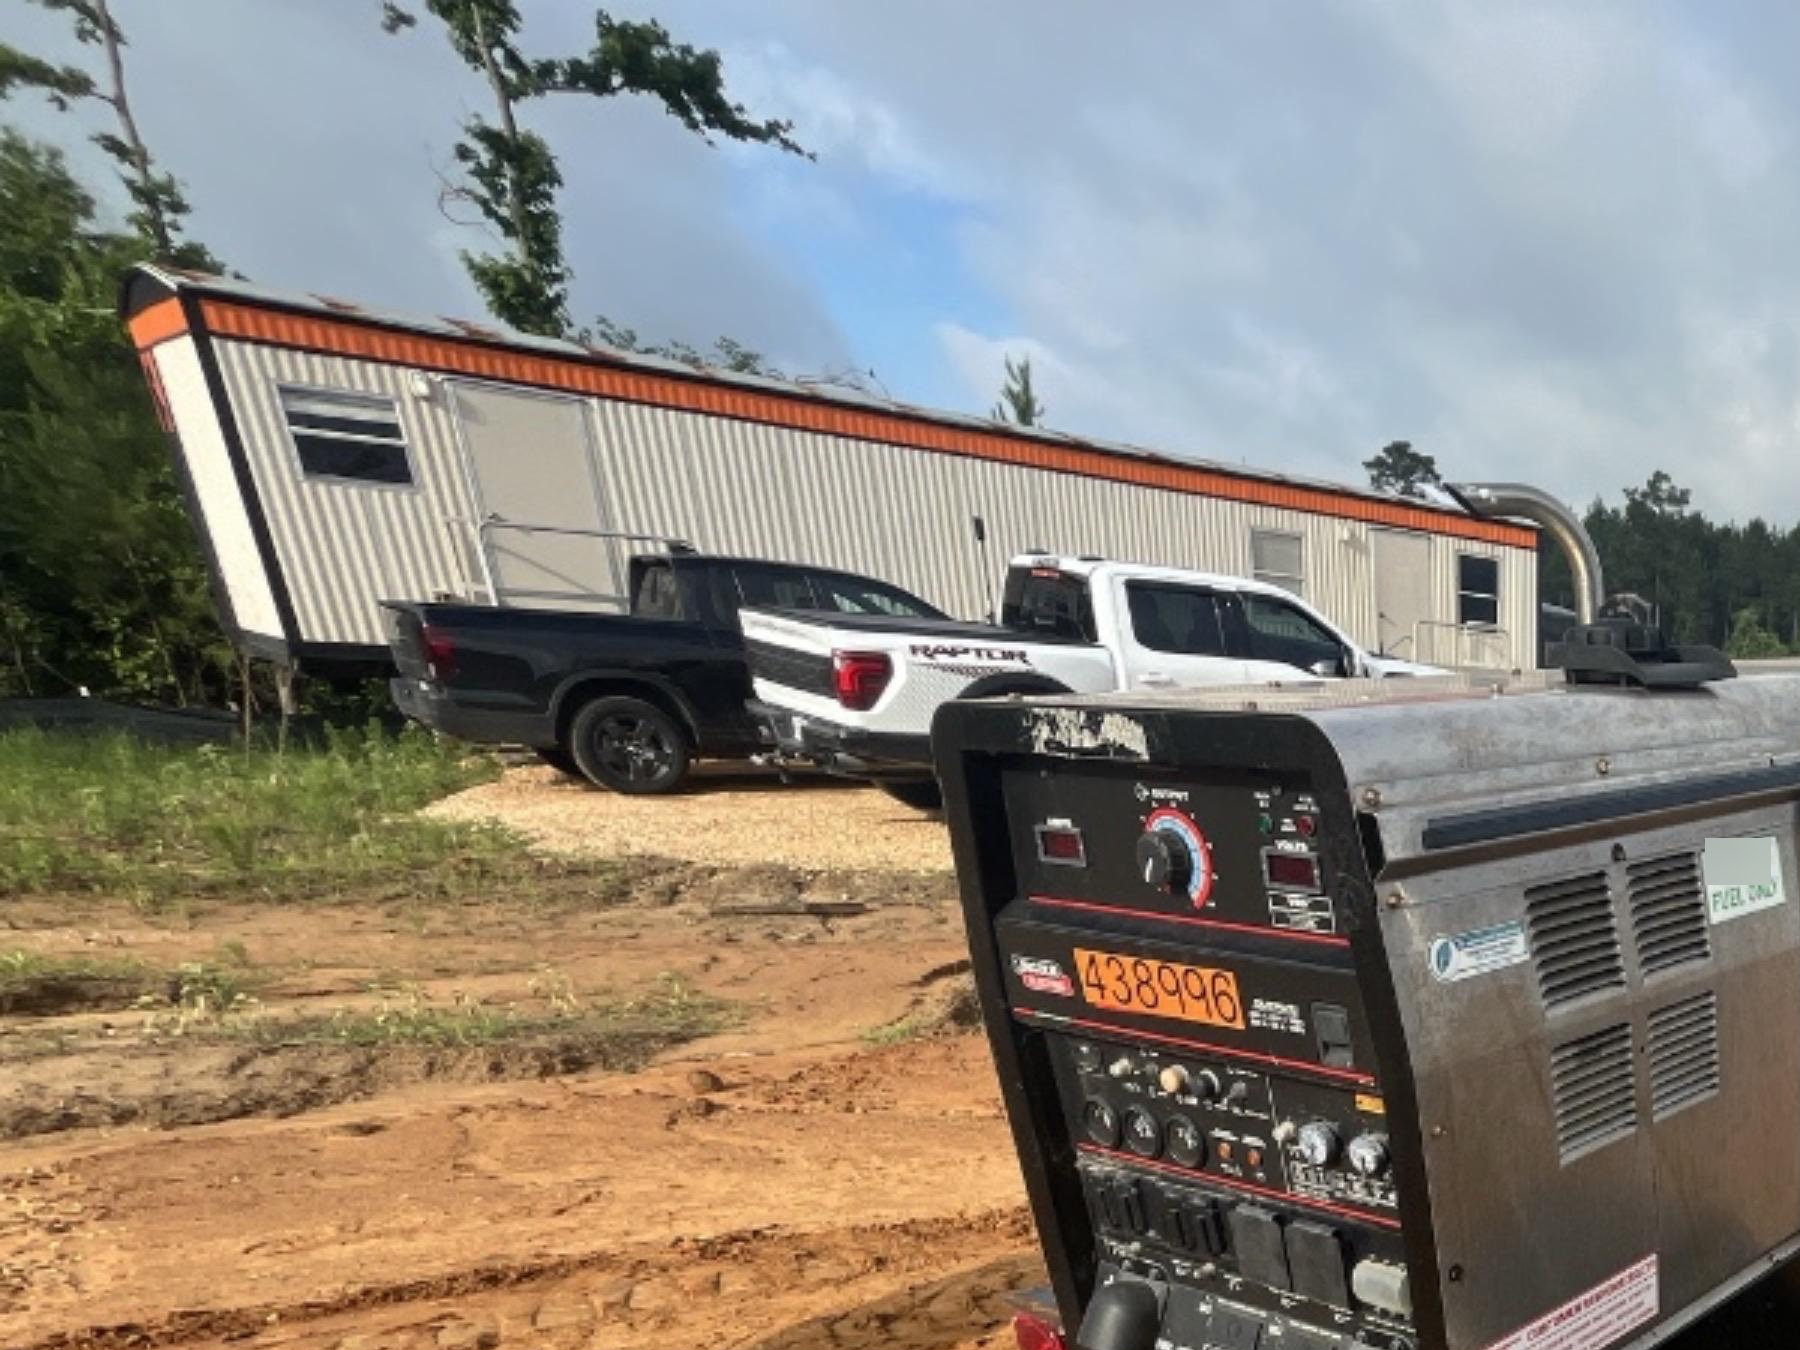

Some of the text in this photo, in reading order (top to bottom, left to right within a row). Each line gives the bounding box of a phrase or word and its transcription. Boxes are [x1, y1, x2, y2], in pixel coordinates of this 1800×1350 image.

[910, 644, 1031, 665] RAPTOR
[1713, 887, 1747, 912] FUEL
[1085, 955, 1237, 1023] 438996
